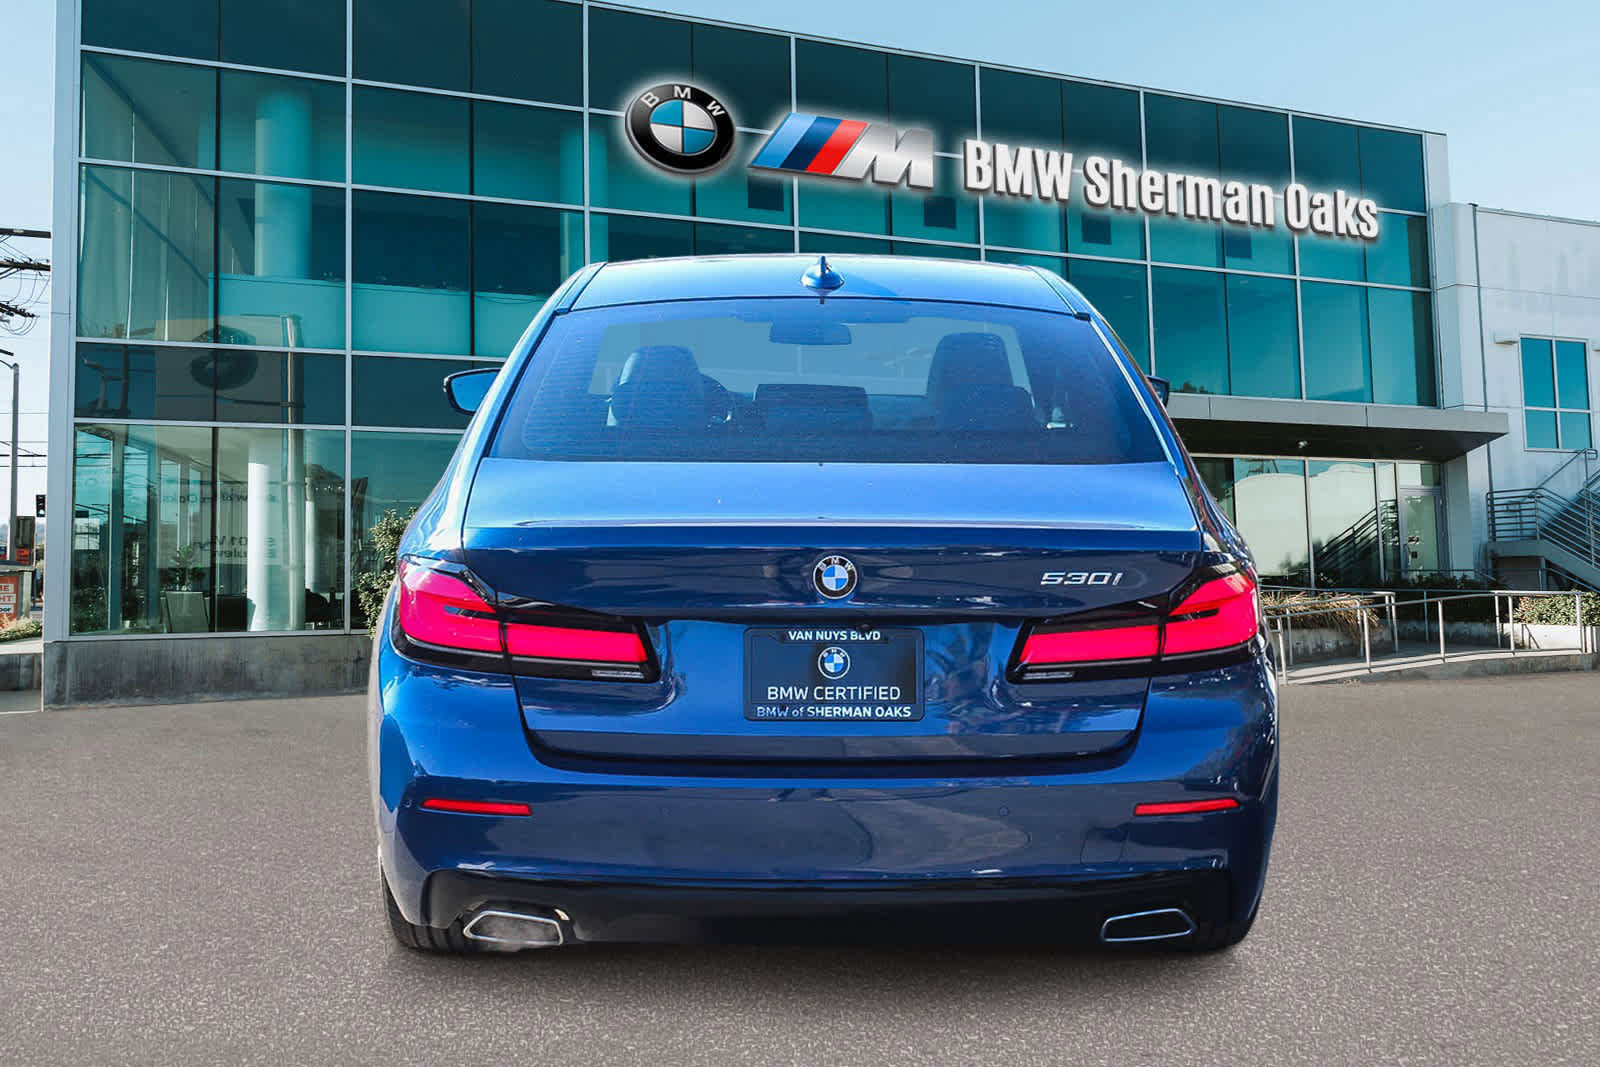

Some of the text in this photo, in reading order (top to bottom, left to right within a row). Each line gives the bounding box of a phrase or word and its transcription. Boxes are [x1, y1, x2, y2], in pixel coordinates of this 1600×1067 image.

[641, 85, 725, 117] BMW
[963, 138, 1379, 243] BMW Sherman Oaks
[1040, 572, 1123, 586] 530i
[788, 631, 881, 641] VAN NUYS BLVD
[767, 686, 901, 700] BMW CERTIFIED
[756, 706, 912, 718] BMW of SHERMAN OAKS
